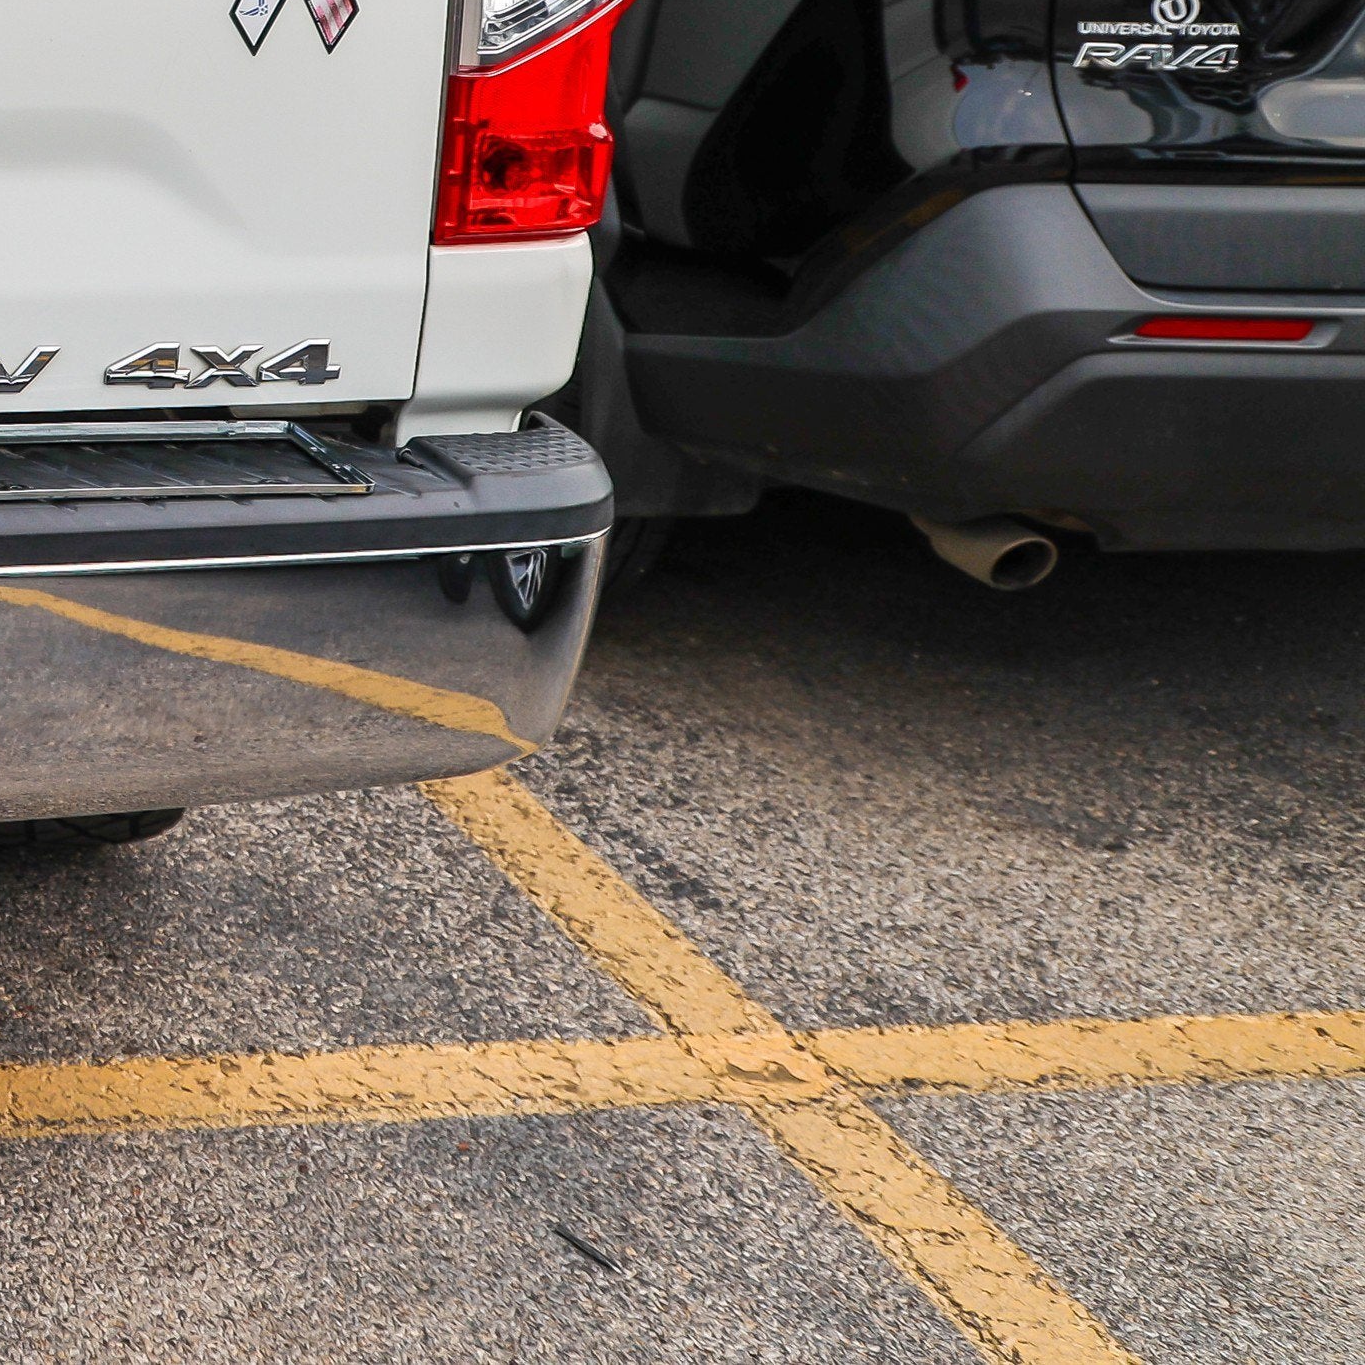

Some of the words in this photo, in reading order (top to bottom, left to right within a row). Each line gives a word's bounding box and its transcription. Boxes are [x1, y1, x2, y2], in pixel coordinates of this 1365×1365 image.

[1076, 21, 1173, 35] UNIVERSAL
[1180, 22, 1241, 36] TOYOTA
[1071, 42, 1239, 73] RAV4
